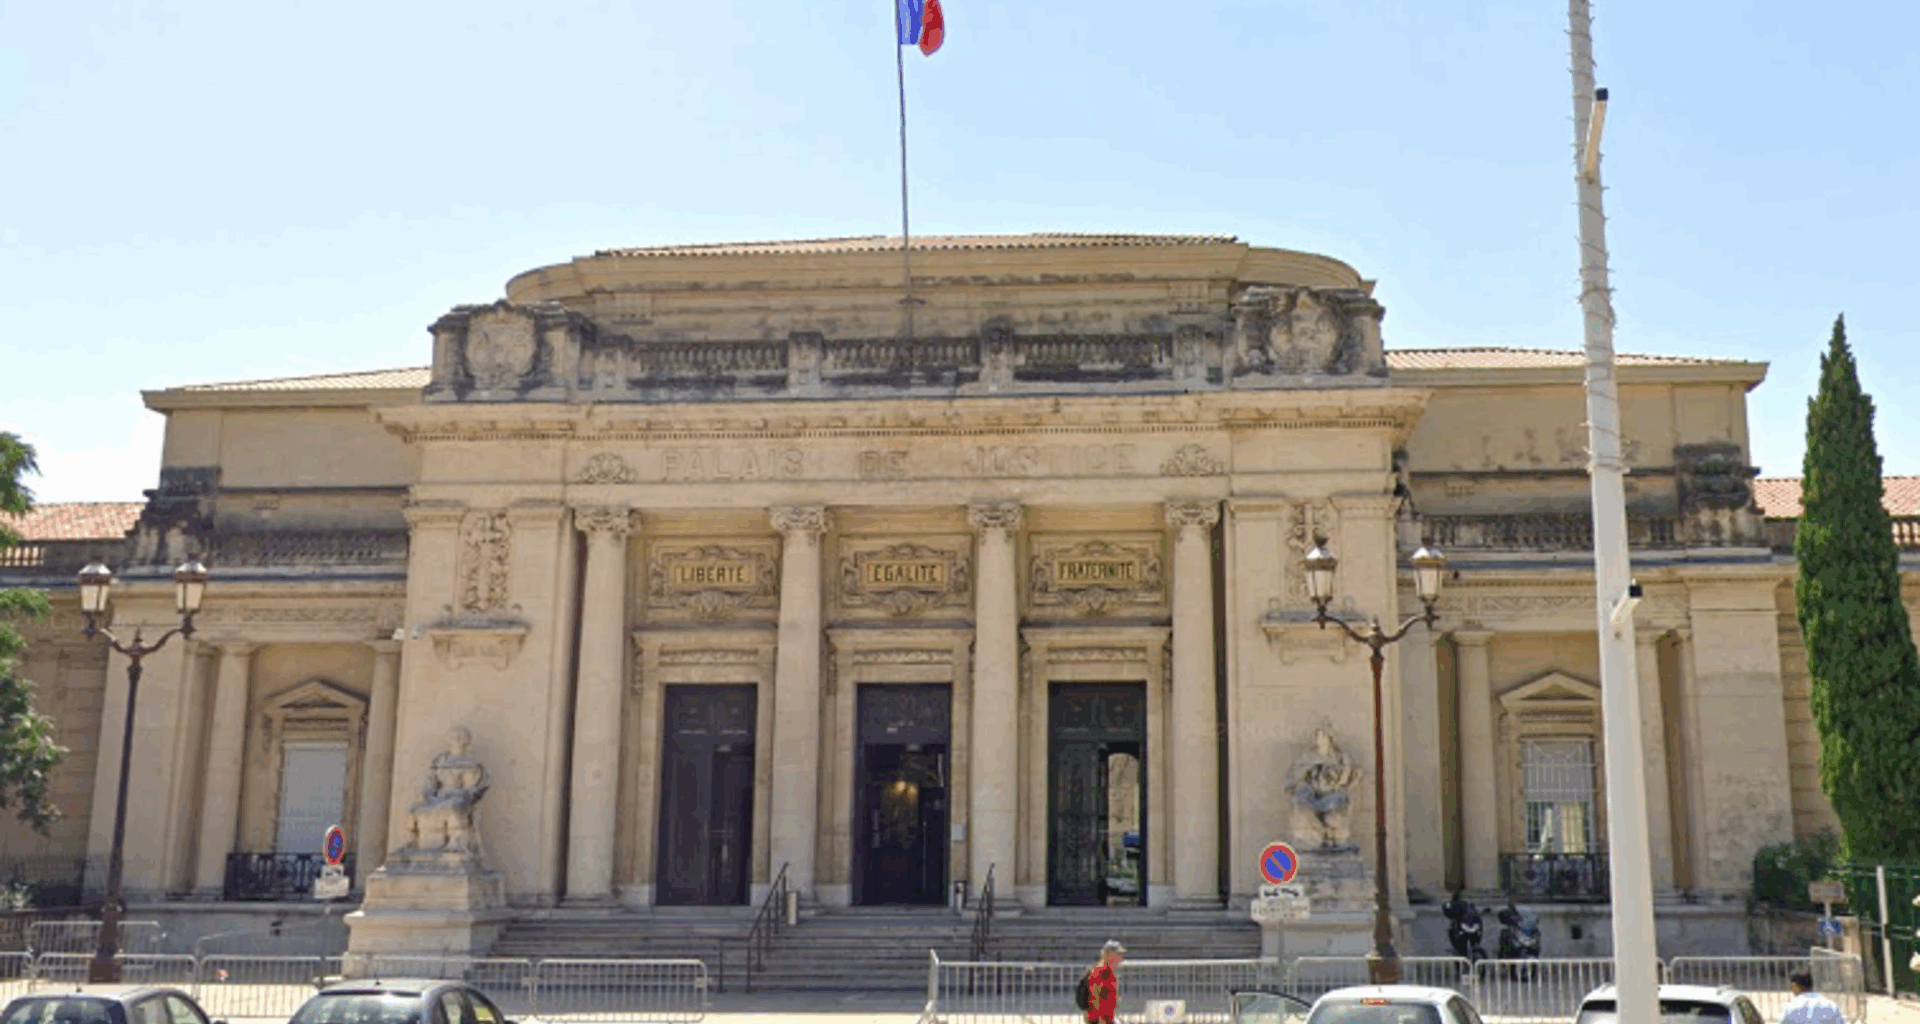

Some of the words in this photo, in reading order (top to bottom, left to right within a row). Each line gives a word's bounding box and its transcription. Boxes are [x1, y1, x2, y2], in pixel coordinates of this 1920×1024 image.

[661, 448, 804, 480] PALAIS
[858, 449, 909, 479] DE
[961, 445, 1137, 477] JUSTICE
